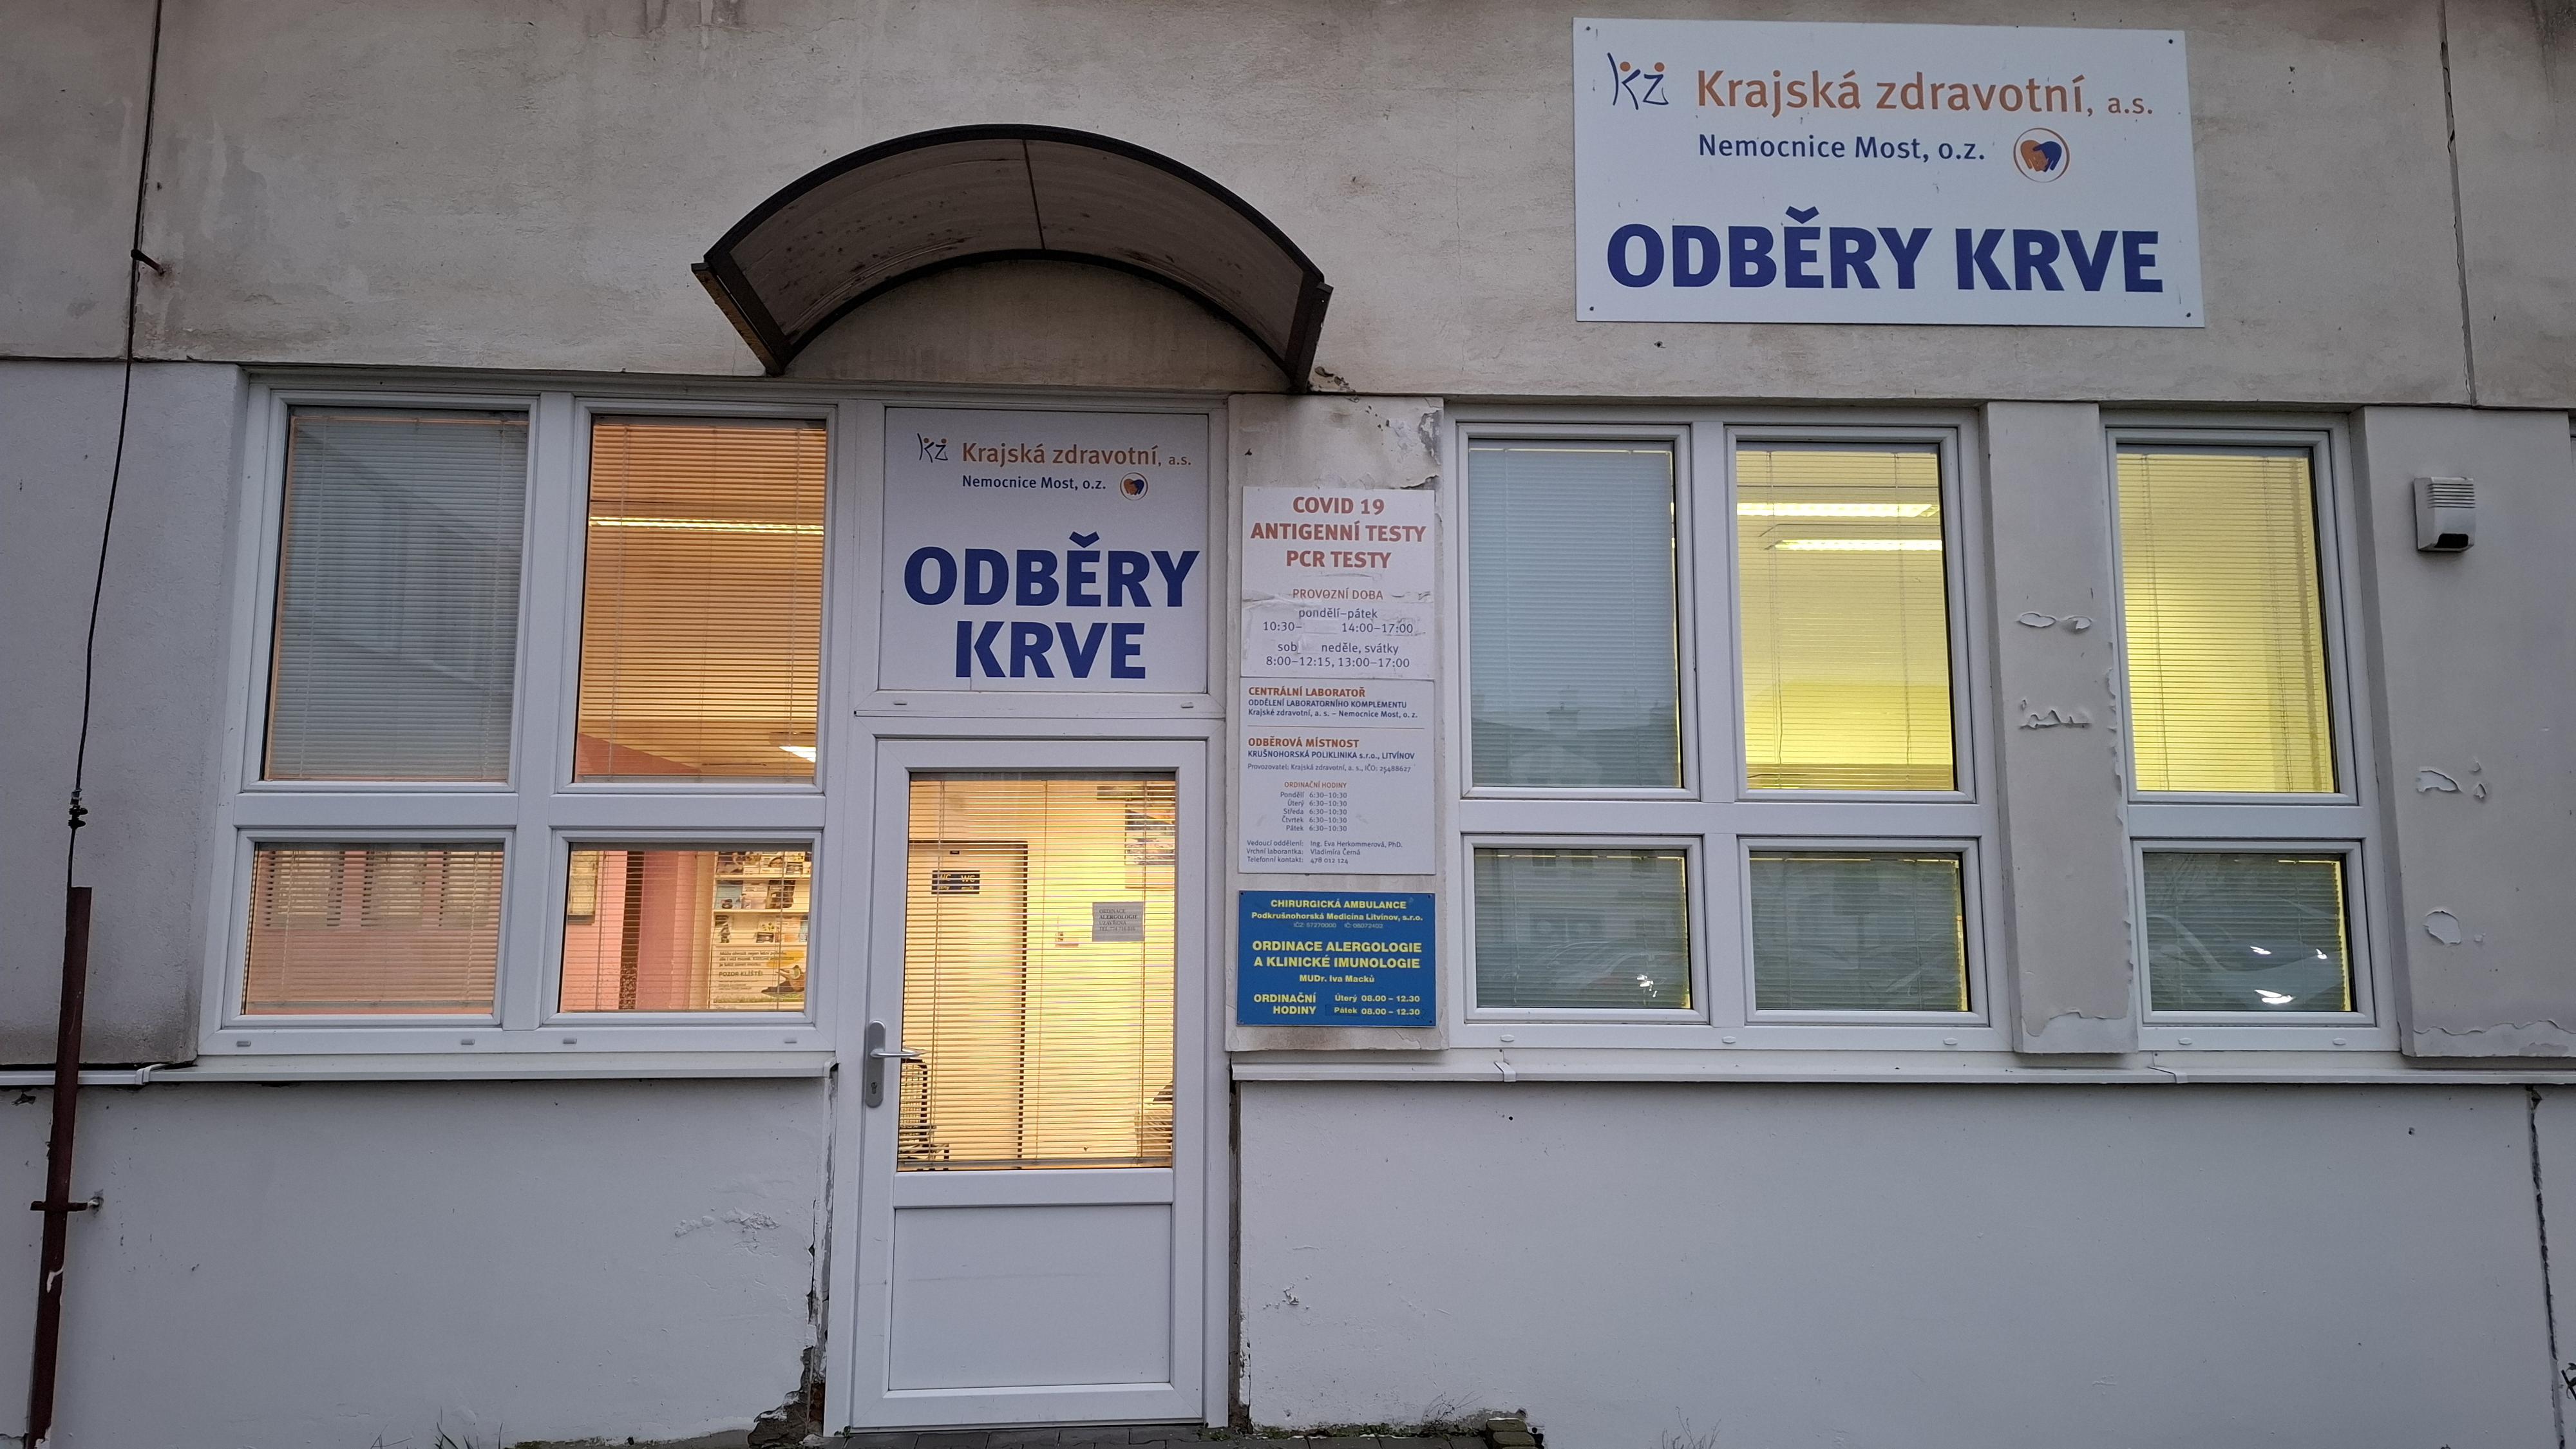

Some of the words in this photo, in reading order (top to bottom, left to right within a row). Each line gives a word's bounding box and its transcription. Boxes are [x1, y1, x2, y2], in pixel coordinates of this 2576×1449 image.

[1697, 69, 1861, 118] Krajská
[1876, 71, 2094, 117] zdravotní,
[2107, 95, 2154, 115] a.s.
[1698, 135, 1845, 160] Nemocnice
[1855, 136, 1929, 163] Most,
[1937, 142, 1985, 161] o.z.
[1607, 206, 1933, 290] ODBĚRY
[1955, 228, 2164, 293] KRVE
[963, 442, 1045, 468] Krajská
[1053, 444, 1162, 467] zdravotní,
[1168, 455, 1192, 466] a.s.
[963, 475, 1037, 488] Nemocnice
[1041, 477, 1078, 491] Most,
[1083, 479, 1106, 489] o.z.
[1293, 496, 1354, 513] COVID
[1361, 498, 1385, 515] 19
[1250, 520, 1360, 541] ANTIGENNÍ
[1365, 525, 1426, 542] TESTY
[1286, 550, 1325, 567] PCR
[1331, 551, 1391, 568] TESTY
[904, 531, 1200, 607] ODBĚRY
[1293, 588, 1349, 599] PROVOZNÍ
[1352, 590, 1383, 600] DOBA
[1298, 608, 1378, 619] pondělí–pátek
[1341, 623, 1413, 634] 14:00–17:00
[956, 620, 1146, 679] KRVE
[1321, 643, 1361, 654] neděle,
[1365, 644, 1399, 654] svátky
[1266, 656, 1334, 668] 8:00–12:15,
[1339, 658, 1410, 668] 13:00–17:00
[1249, 686, 1303, 696] CENTRÁLNÍ
[1305, 687, 1365, 697] LABORATOŘ
[1286, 699, 1349, 708] LABORATORNÍHO
[1248, 709, 1274, 717] Krajské
[1276, 708, 1312, 717] zdravotní,
[1248, 735, 1303, 747] ODBĚROVÁ
[1305, 737, 1359, 748] MÍSTNOST
[1247, 750, 1309, 758] KRUŠNOHORSKÁ
[1382, 751, 1415, 760] LITVÍNOV
[1271, 898, 1341, 909] CHIRURGICKÁ
[1365, 913, 1400, 922] Litvínov,
[1253, 942, 1323, 951] ORDINACE
[1326, 942, 1422, 952] ALERGOLOGIE
[1254, 957, 1263, 966] A
[1267, 954, 1330, 967] KLINICKÉ
[1334, 958, 1420, 969] IMUNOLOGIE
[1254, 992, 1316, 1003] ORDINAČNÍ
[1334, 994, 1358, 1003] Úterý
[1273, 1006, 1316, 1015] HODINY
